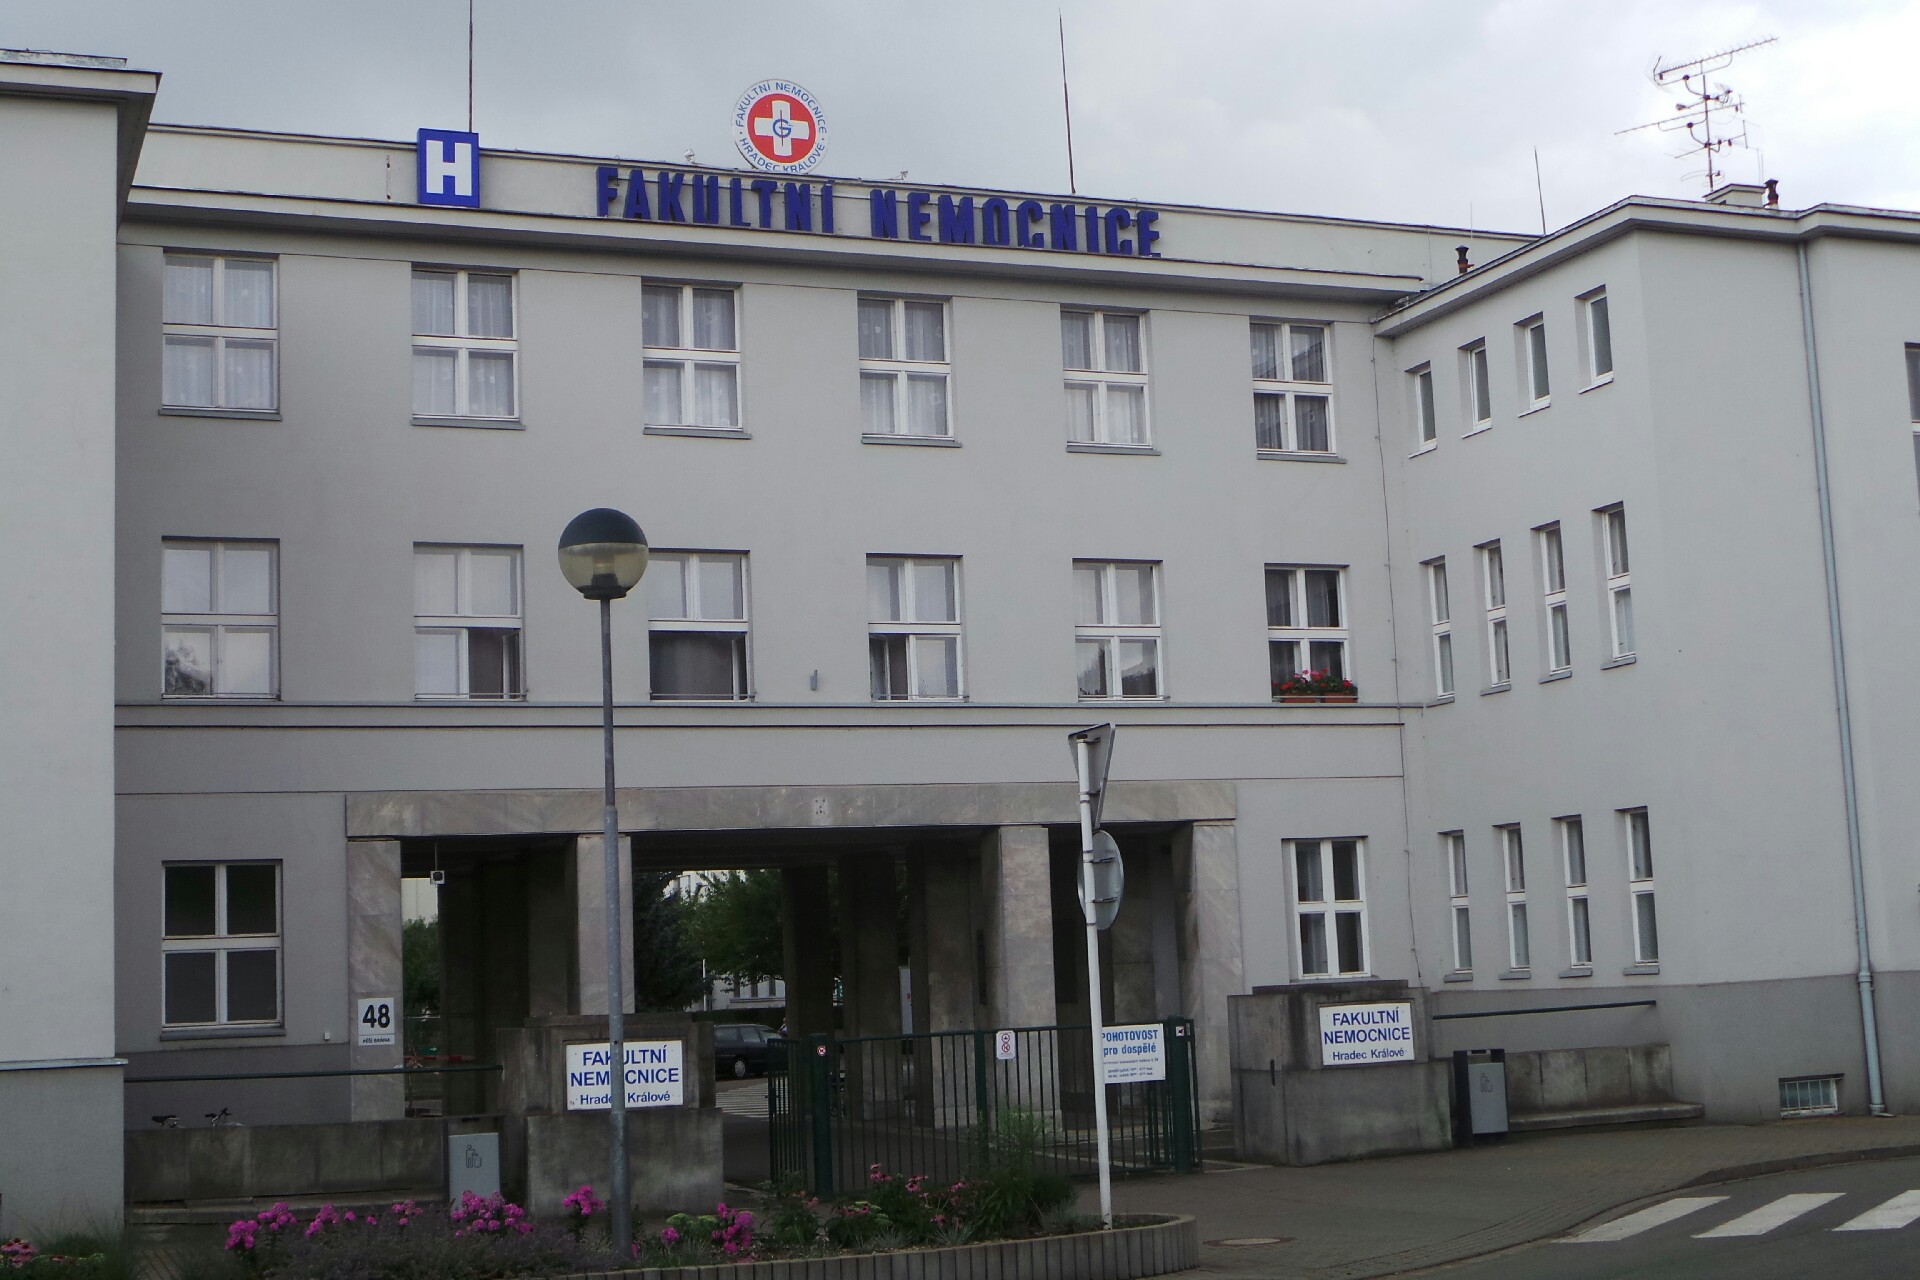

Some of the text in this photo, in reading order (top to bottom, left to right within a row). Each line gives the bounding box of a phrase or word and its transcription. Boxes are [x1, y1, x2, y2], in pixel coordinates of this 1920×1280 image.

[776, 82, 828, 134] NEMOCNICE
[426, 139, 472, 197] H
[596, 166, 1162, 258] FAKULTNÍ NEMOCNICE
[362, 1004, 391, 1029] 48
[1332, 1006, 1399, 1026] FAKULTNÍ
[1323, 1027, 1411, 1045] NEMOCNICE
[1103, 1042, 1157, 1058] pro dospělé
[1332, 1047, 1405, 1061] Hradec Králové
[570, 1067, 679, 1087] NEMCNICE
[627, 1090, 671, 1103] Králové
